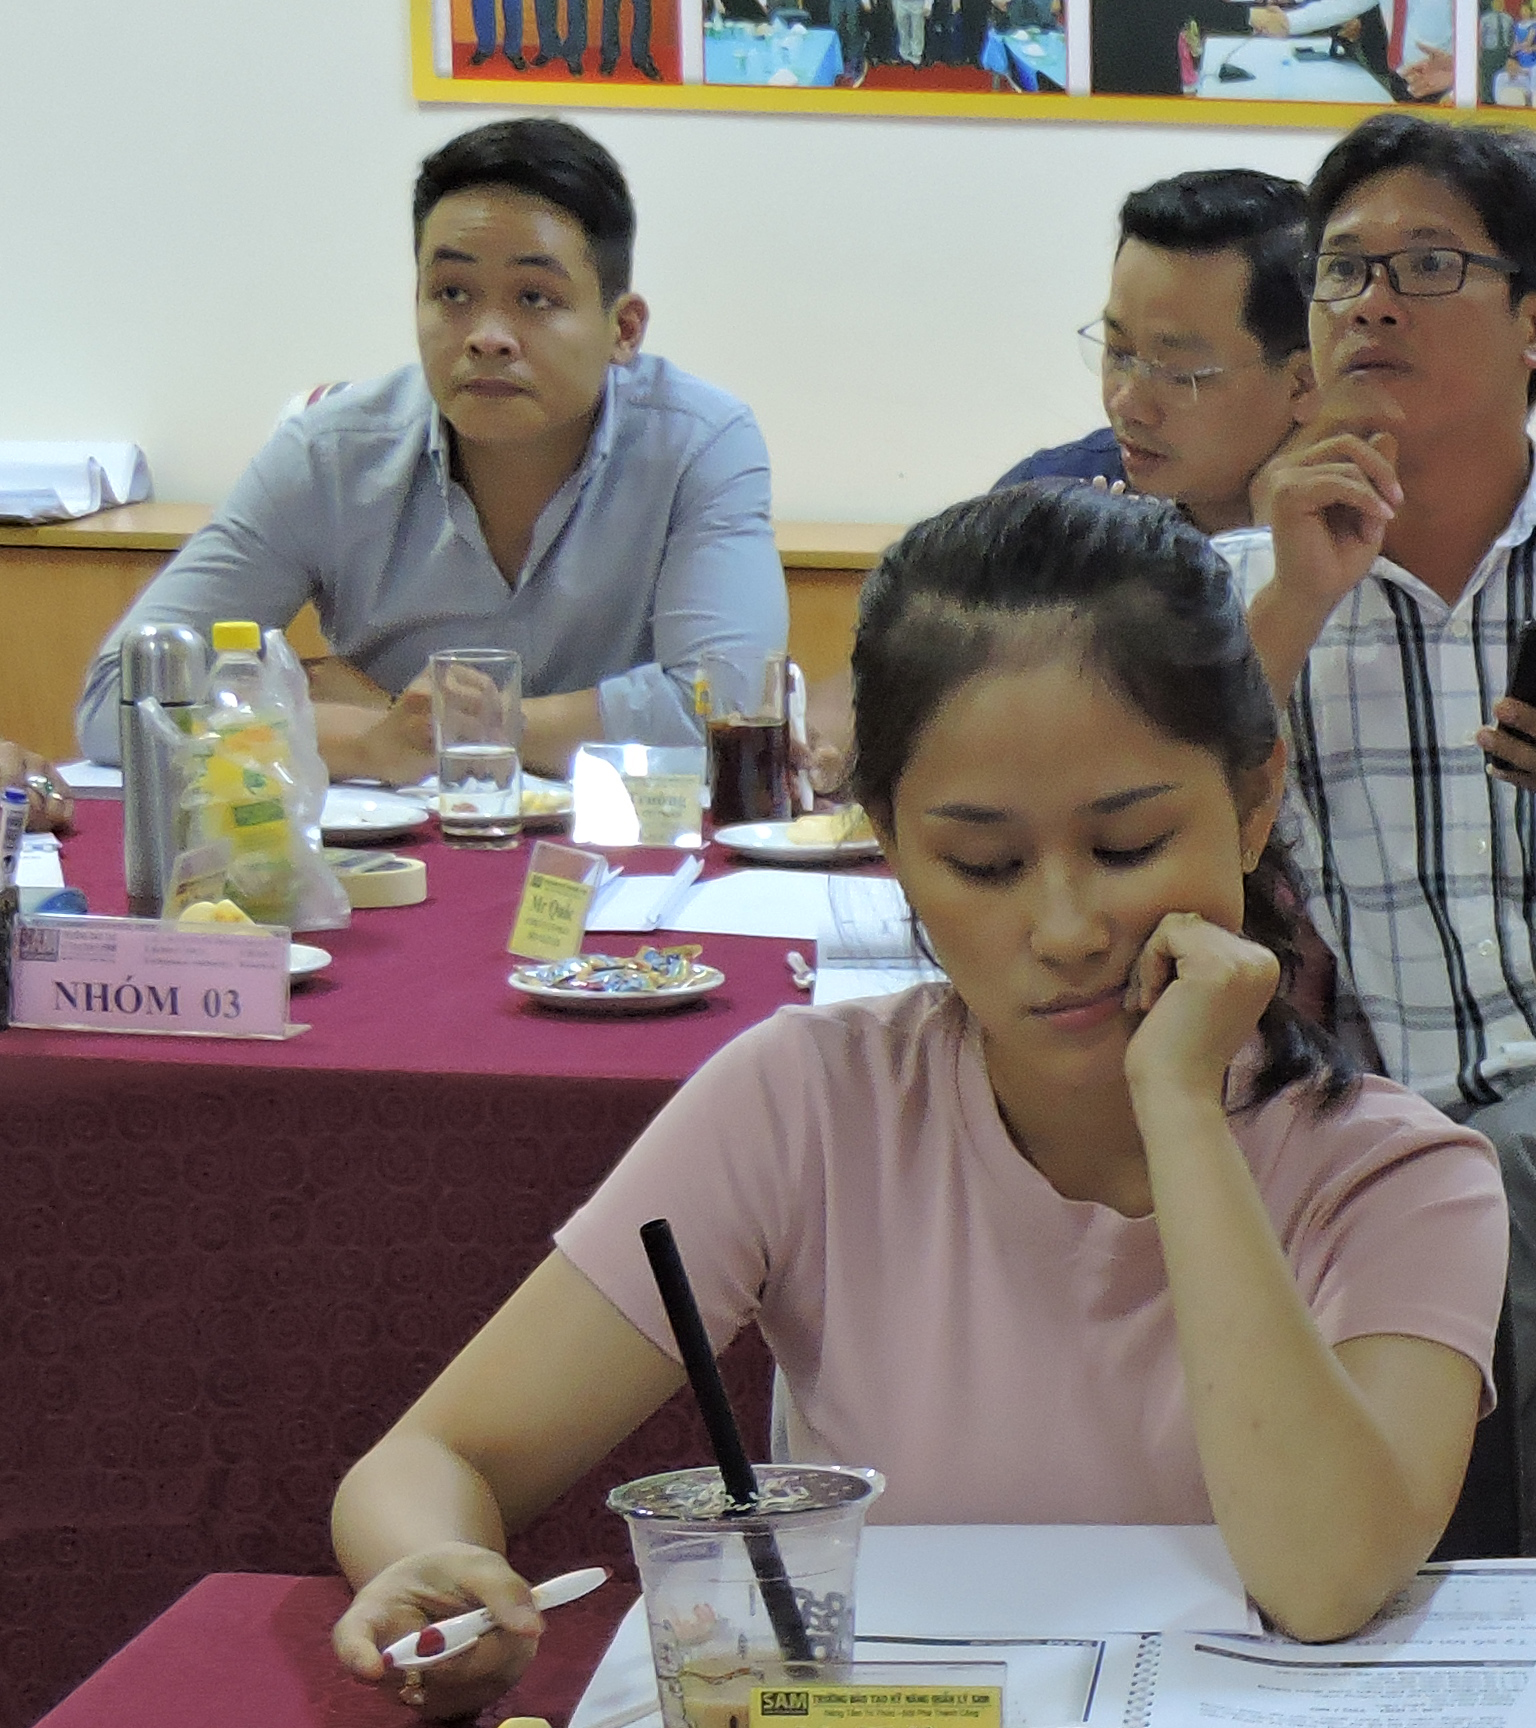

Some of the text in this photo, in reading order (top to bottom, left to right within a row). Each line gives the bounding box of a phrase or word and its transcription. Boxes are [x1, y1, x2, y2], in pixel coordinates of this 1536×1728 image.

[55, 975, 242, 1019] NHÓM 03
[762, 1692, 808, 1711] SAM
